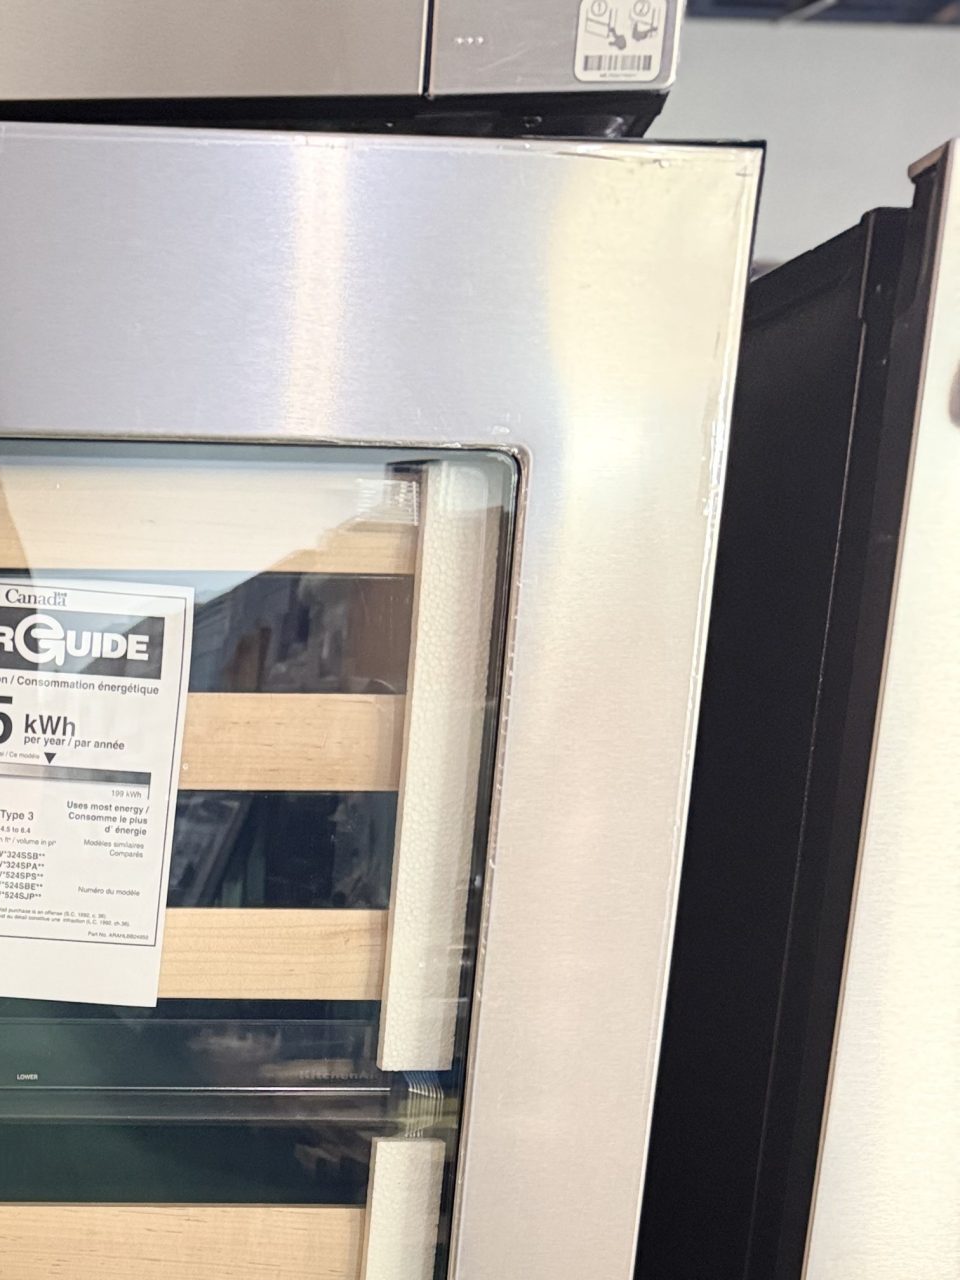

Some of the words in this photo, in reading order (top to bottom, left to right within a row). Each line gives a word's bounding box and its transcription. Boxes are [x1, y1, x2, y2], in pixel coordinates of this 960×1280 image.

[5, 588, 68, 607] Canada
[17, 675, 95, 690] Consommation
[98, 679, 159, 696] énergétique
[24, 713, 76, 737] kWh
[23, 735, 41, 746] per
[43, 737, 66, 748] year
[74, 739, 92, 750] par
[93, 740, 125, 751] année
[9, 751, 19, 759] Ce
[111, 789, 124, 798] 199
[126, 790, 142, 799] kWh
[66, 800, 88, 810] Uses
[90, 802, 112, 812] most
[114, 804, 144, 815] energy
[0, 809, 25, 822] Type
[27, 811, 34, 821] 3
[68, 811, 117, 823] Consomme
[119, 814, 127, 824] le
[129, 815, 148, 825] plus
[115, 825, 147, 837] énergie
[16, 838, 40, 846] volume
[83, 839, 112, 848] Modèles
[113, 840, 144, 849] similaires
[109, 849, 144, 858] Comparés
[78, 885, 105, 895] Numéro
[116, 887, 140, 897] modèle
[16, 1073, 38, 1081] LOWER
